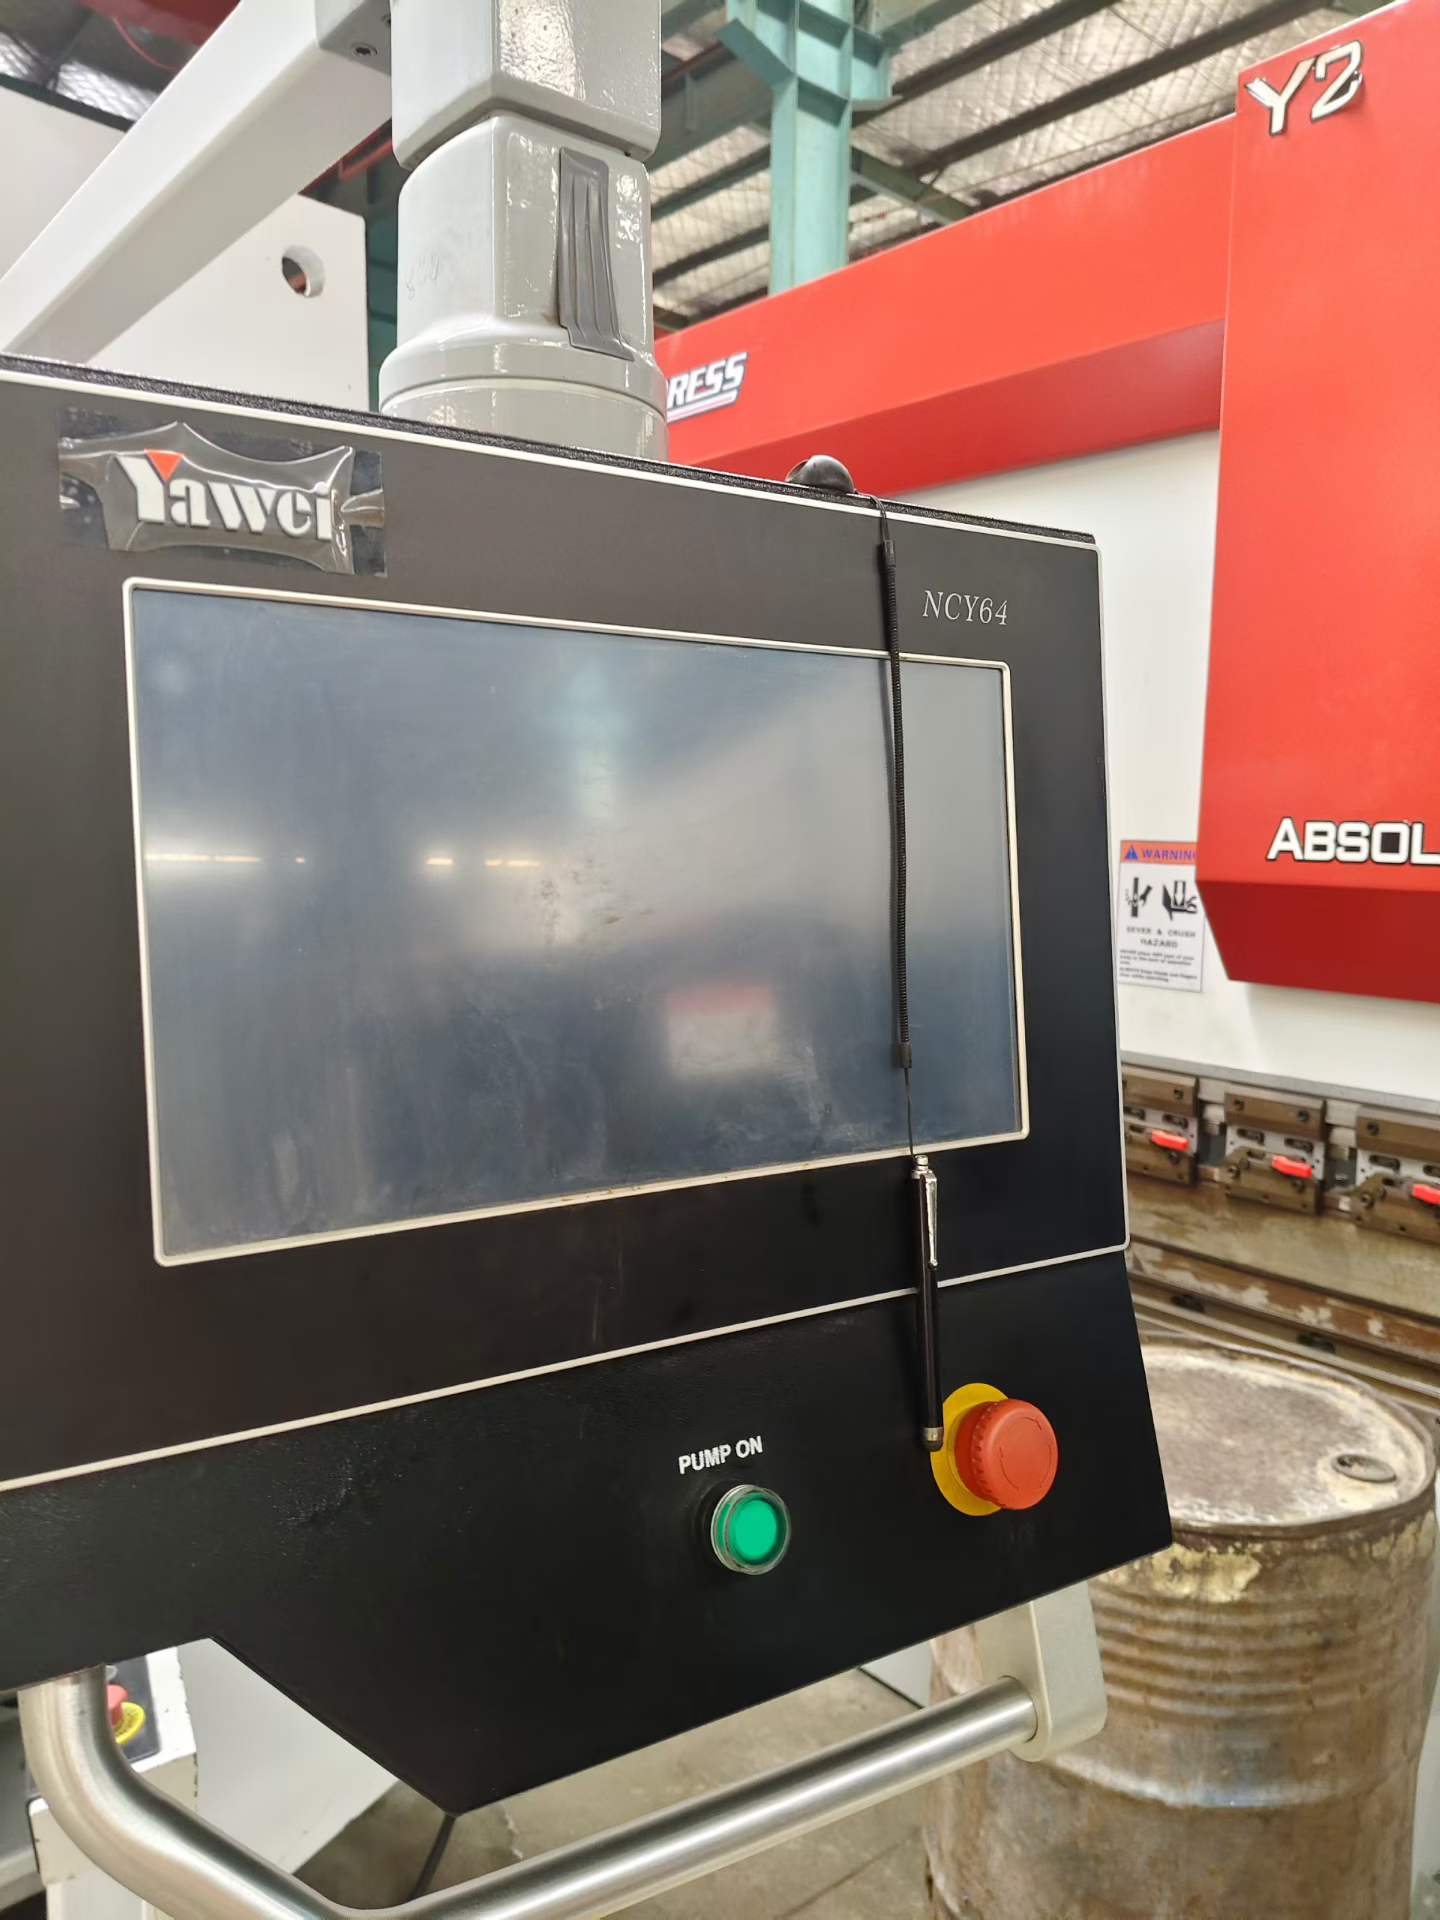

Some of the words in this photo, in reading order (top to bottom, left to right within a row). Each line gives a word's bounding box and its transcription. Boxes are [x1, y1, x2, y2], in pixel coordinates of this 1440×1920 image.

[1246, 40, 1363, 136] Y2
[665, 352, 748, 409] RESS
[115, 450, 333, 541] Yawei
[922, 590, 1008, 625] NCY64
[1142, 848, 1197, 861] WARNIN
[1266, 817, 1440, 865] ABSOL
[678, 1444, 732, 1475] PUMP
[735, 1435, 763, 1458] ON
